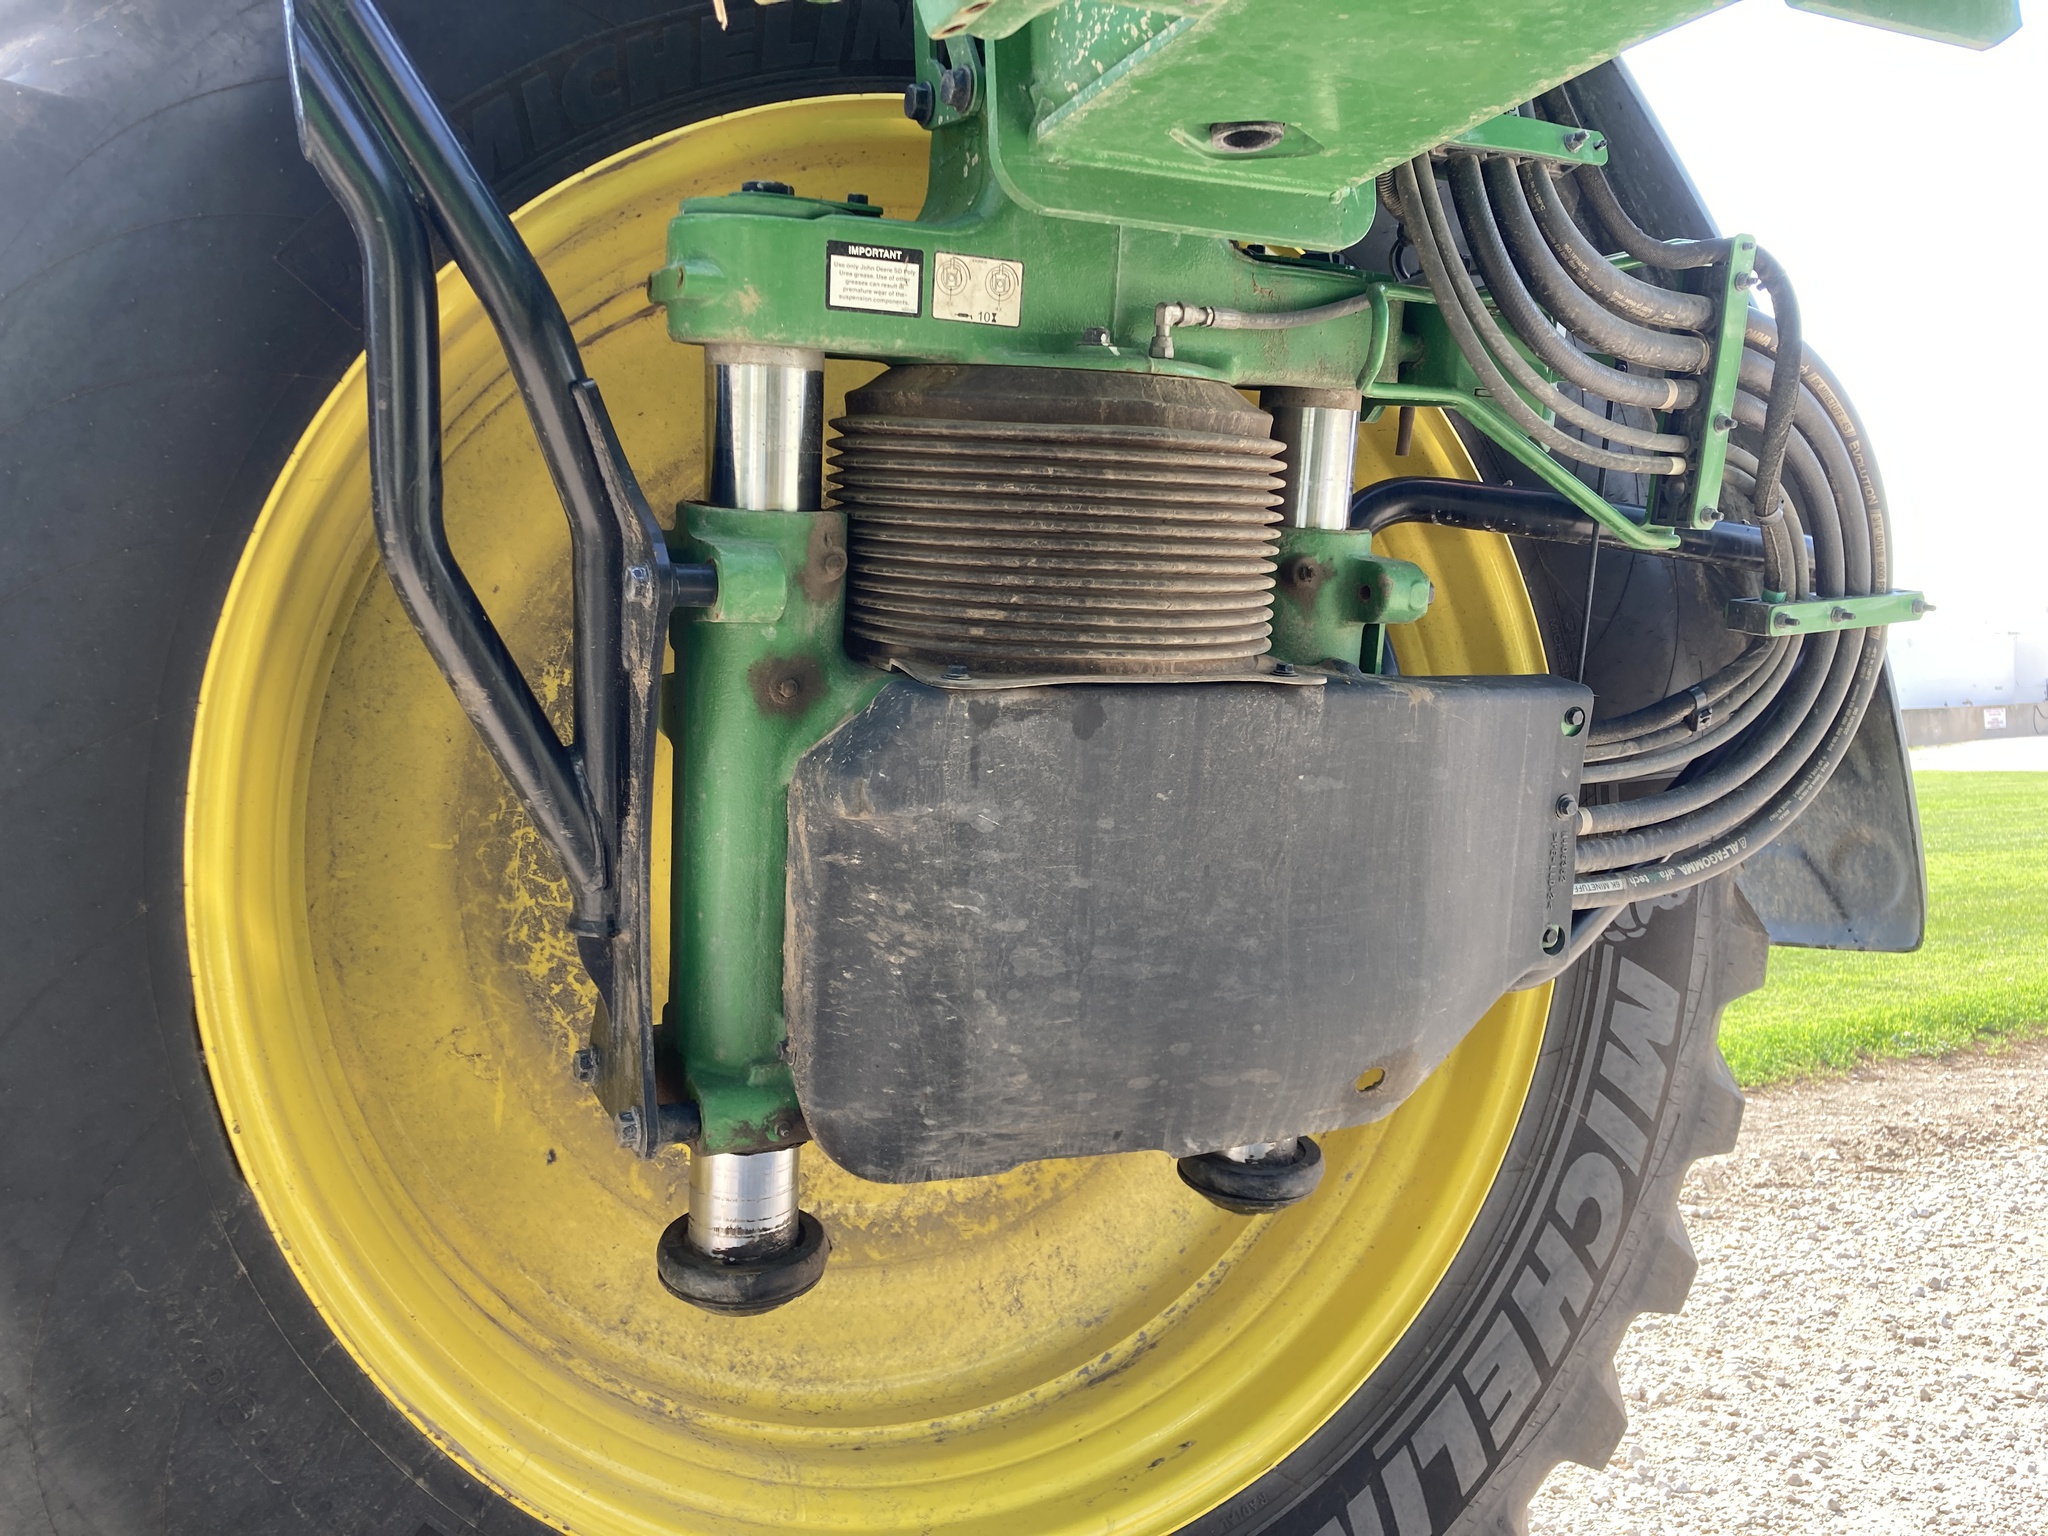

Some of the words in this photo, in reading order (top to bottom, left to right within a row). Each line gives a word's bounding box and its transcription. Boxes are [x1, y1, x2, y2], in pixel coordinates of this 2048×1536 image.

[848, 245, 902, 260] IMPORTANT
[904, 269, 916, 277] Poly
[873, 298, 909, 306] components.
[978, 311, 991, 322] 10
[1745, 329, 1772, 347] OMMA
[1819, 386, 1844, 417] MINETUFF
[1842, 422, 1852, 432] 4S
[1850, 440, 1879, 506] EVOLUTION
[1875, 580, 1885, 594] PS
[1678, 842, 1739, 876] ALFAGOMMA
[1574, 882, 1609, 892] MINETUFF
